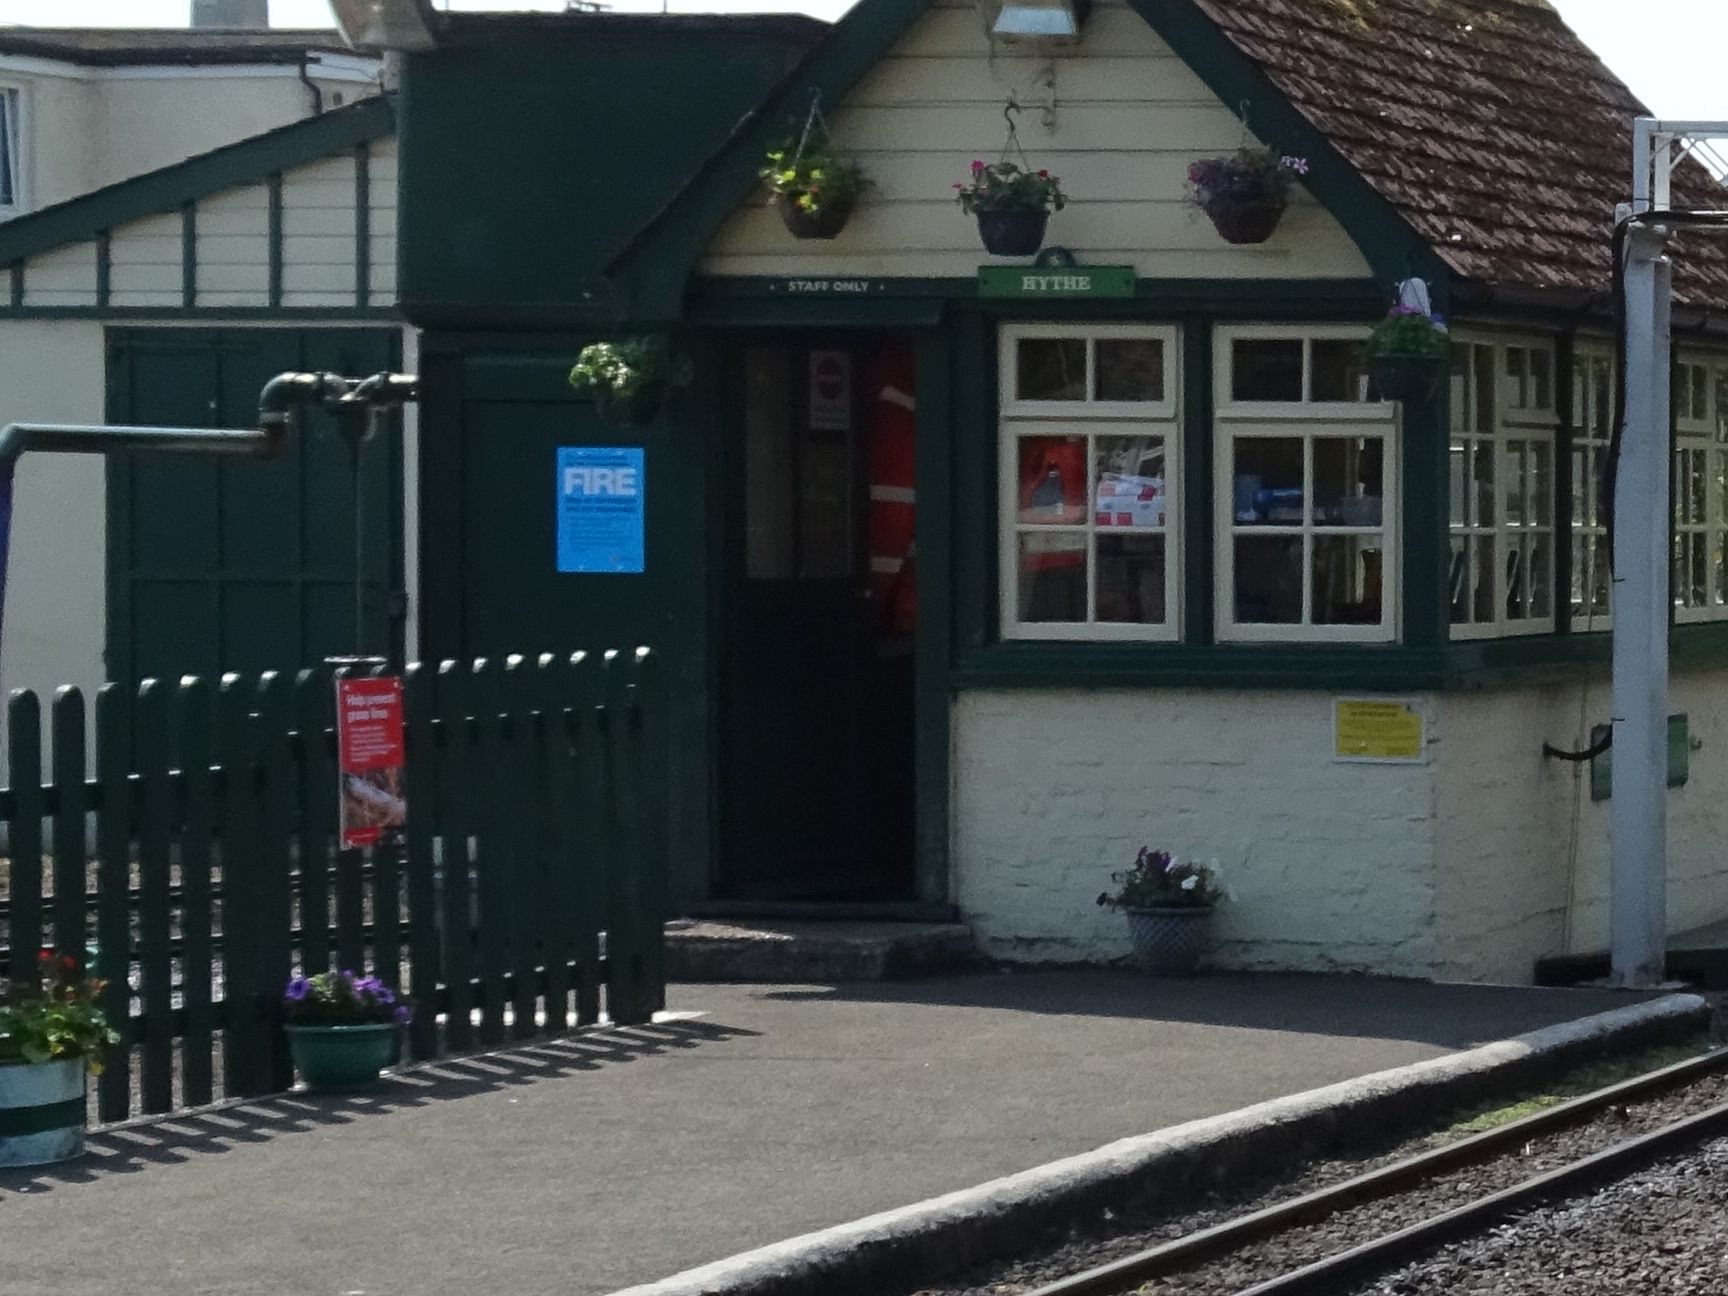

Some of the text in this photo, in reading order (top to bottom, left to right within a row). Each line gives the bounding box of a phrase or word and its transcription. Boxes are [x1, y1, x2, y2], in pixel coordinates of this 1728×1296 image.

[788, 281, 869, 292] STAFF ONLY
[1022, 275, 1092, 291] HYTHE
[564, 467, 637, 495] FIRE
